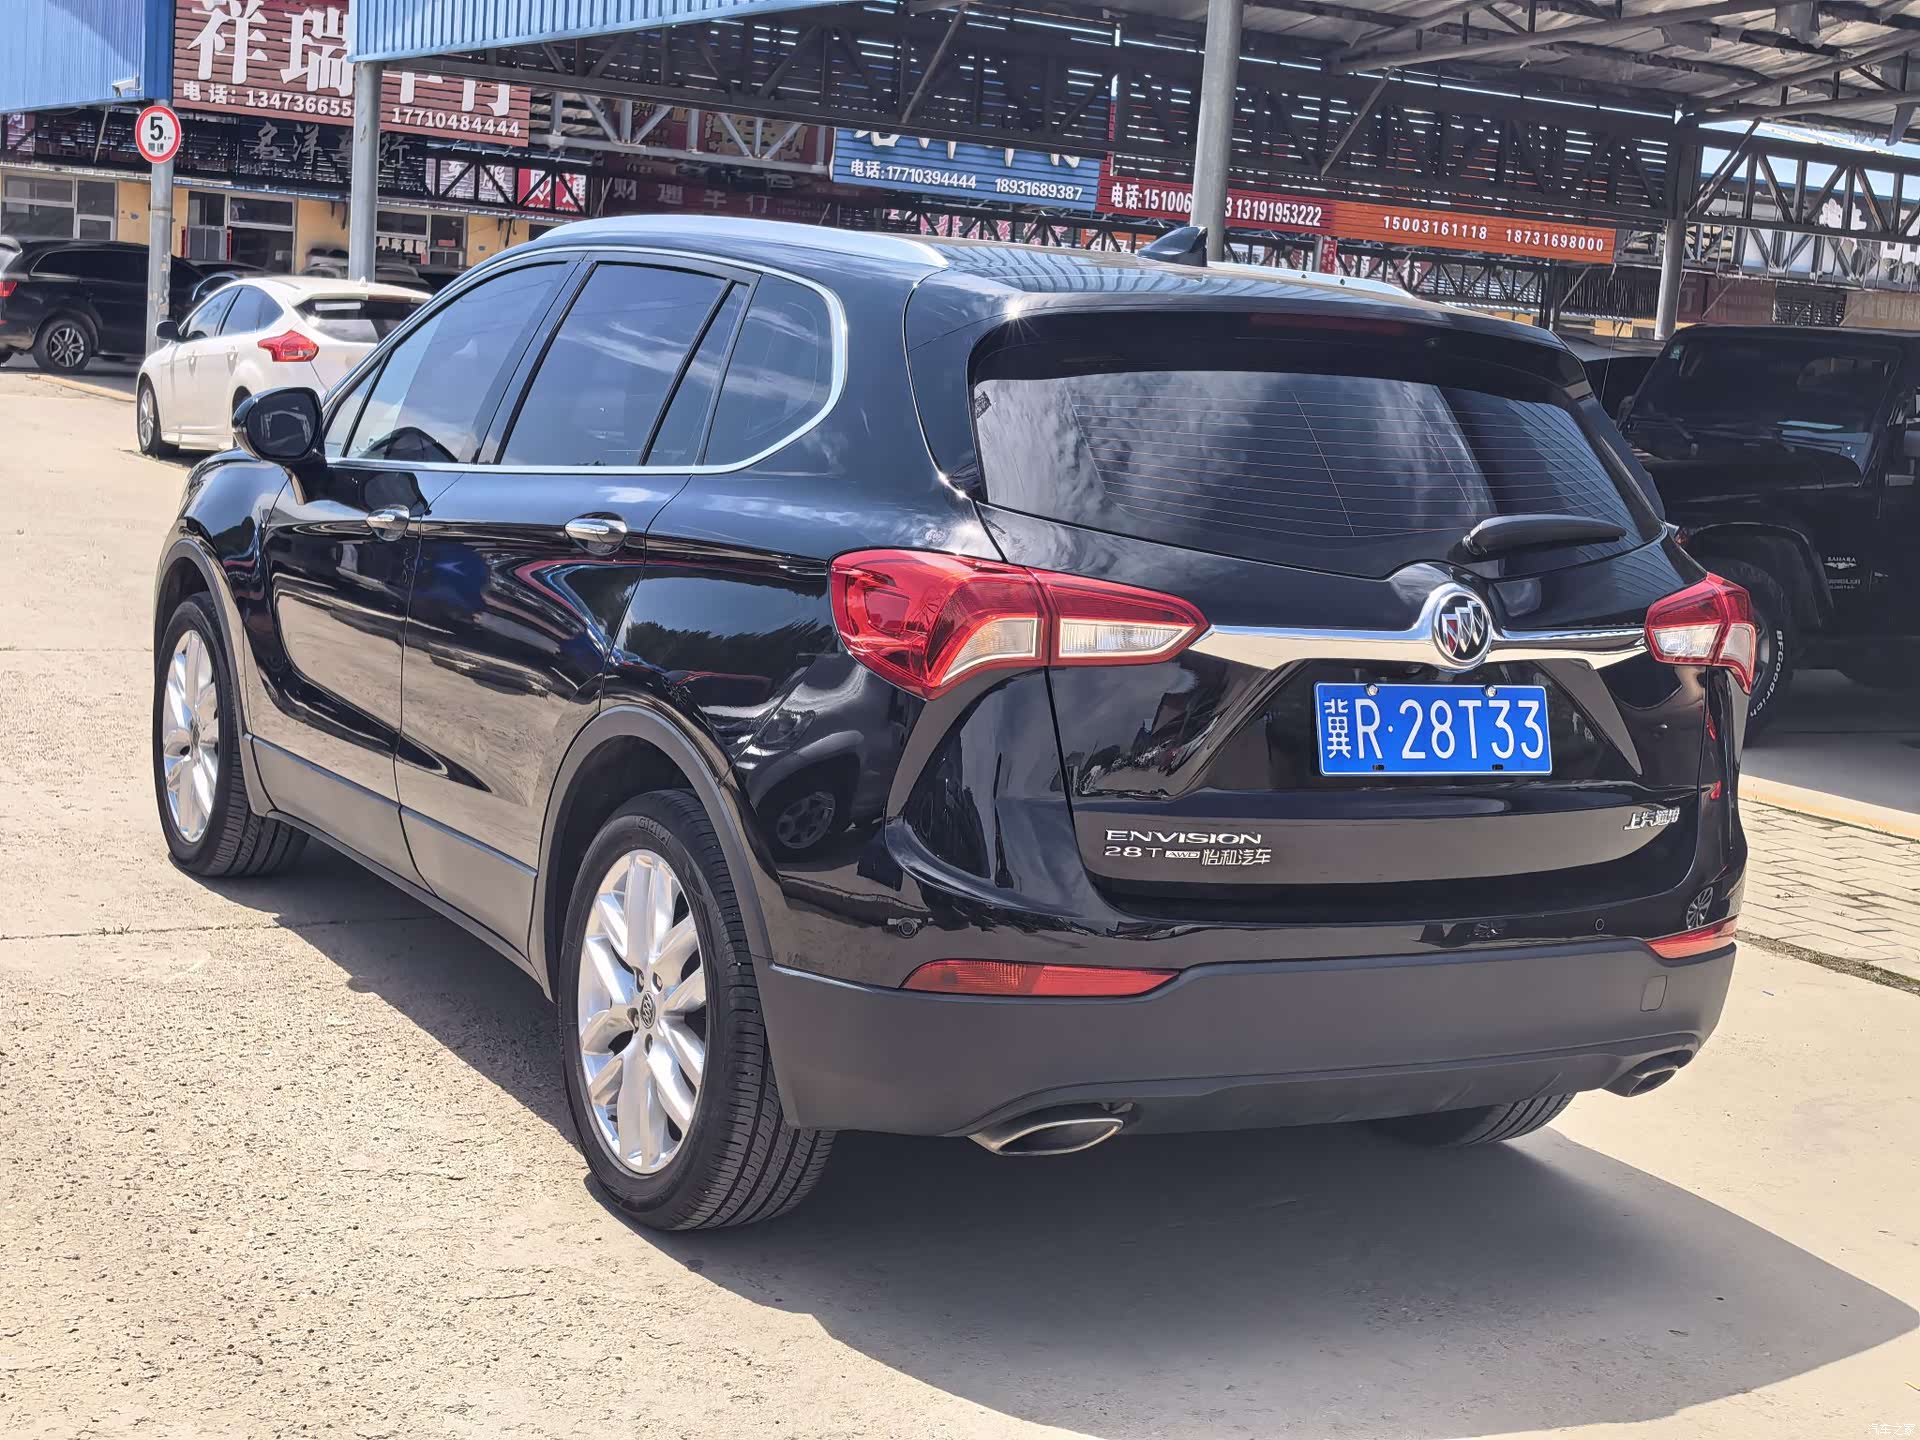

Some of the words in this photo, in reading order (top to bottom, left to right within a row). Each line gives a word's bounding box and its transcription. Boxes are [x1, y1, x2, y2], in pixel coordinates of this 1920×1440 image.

[245, 89, 354, 118] 134736655
[391, 107, 520, 138] 17710484444
[150, 116, 164, 141] 5
[994, 177, 1084, 201] 18931689387
[1236, 198, 1322, 227] 13191953222
[1383, 215, 1488, 240] 15003161118
[1506, 228, 1604, 252] 18731698000
[1750, 629, 1784, 717] BFGoodrich
[1323, 698, 1544, 760] 冀R·28T33
[1105, 829, 1262, 845] ENVISION
[1165, 850, 1200, 859] AWD
